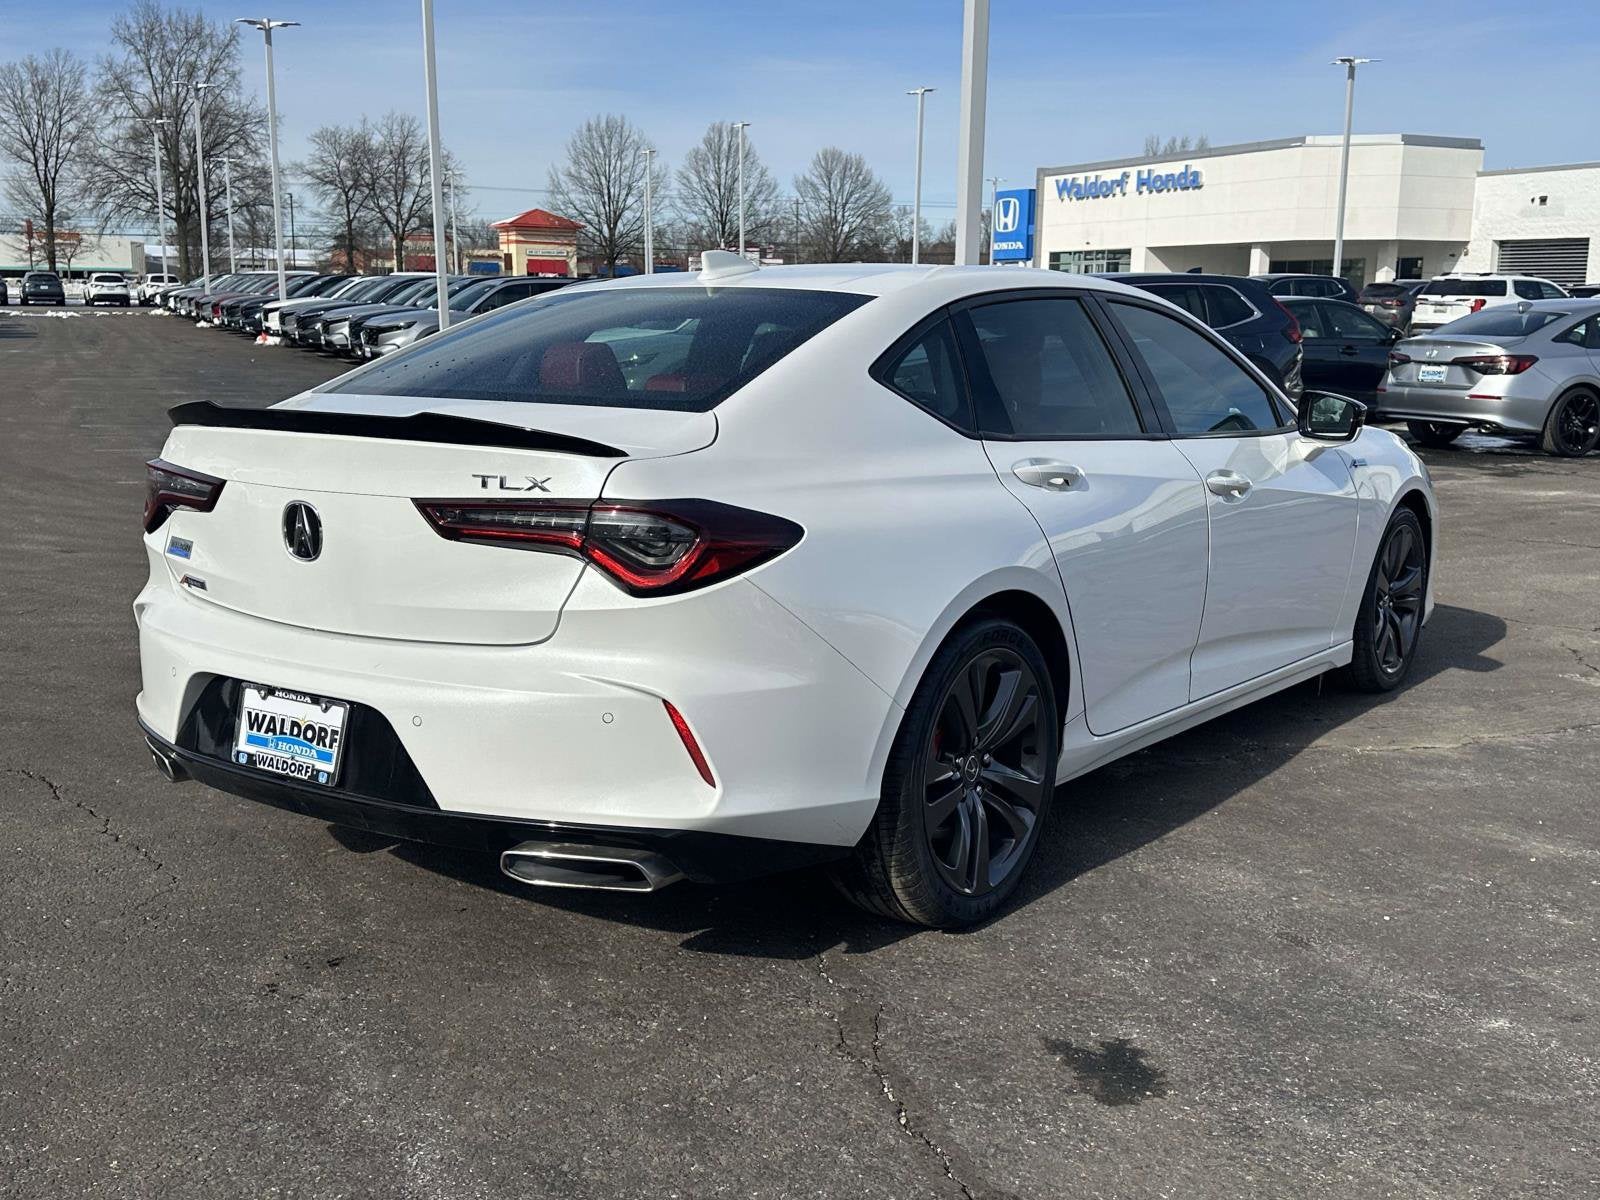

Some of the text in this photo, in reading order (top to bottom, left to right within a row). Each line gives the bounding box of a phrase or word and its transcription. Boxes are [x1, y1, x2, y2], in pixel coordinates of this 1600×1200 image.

[1055, 164, 1203, 201] Waldorf Honda
[472, 474, 552, 492] TLX
[274, 690, 312, 703] HONDA
[246, 710, 340, 750] WALDORF
[277, 742, 318, 758] HONDA
[257, 754, 311, 777] WALDORF
